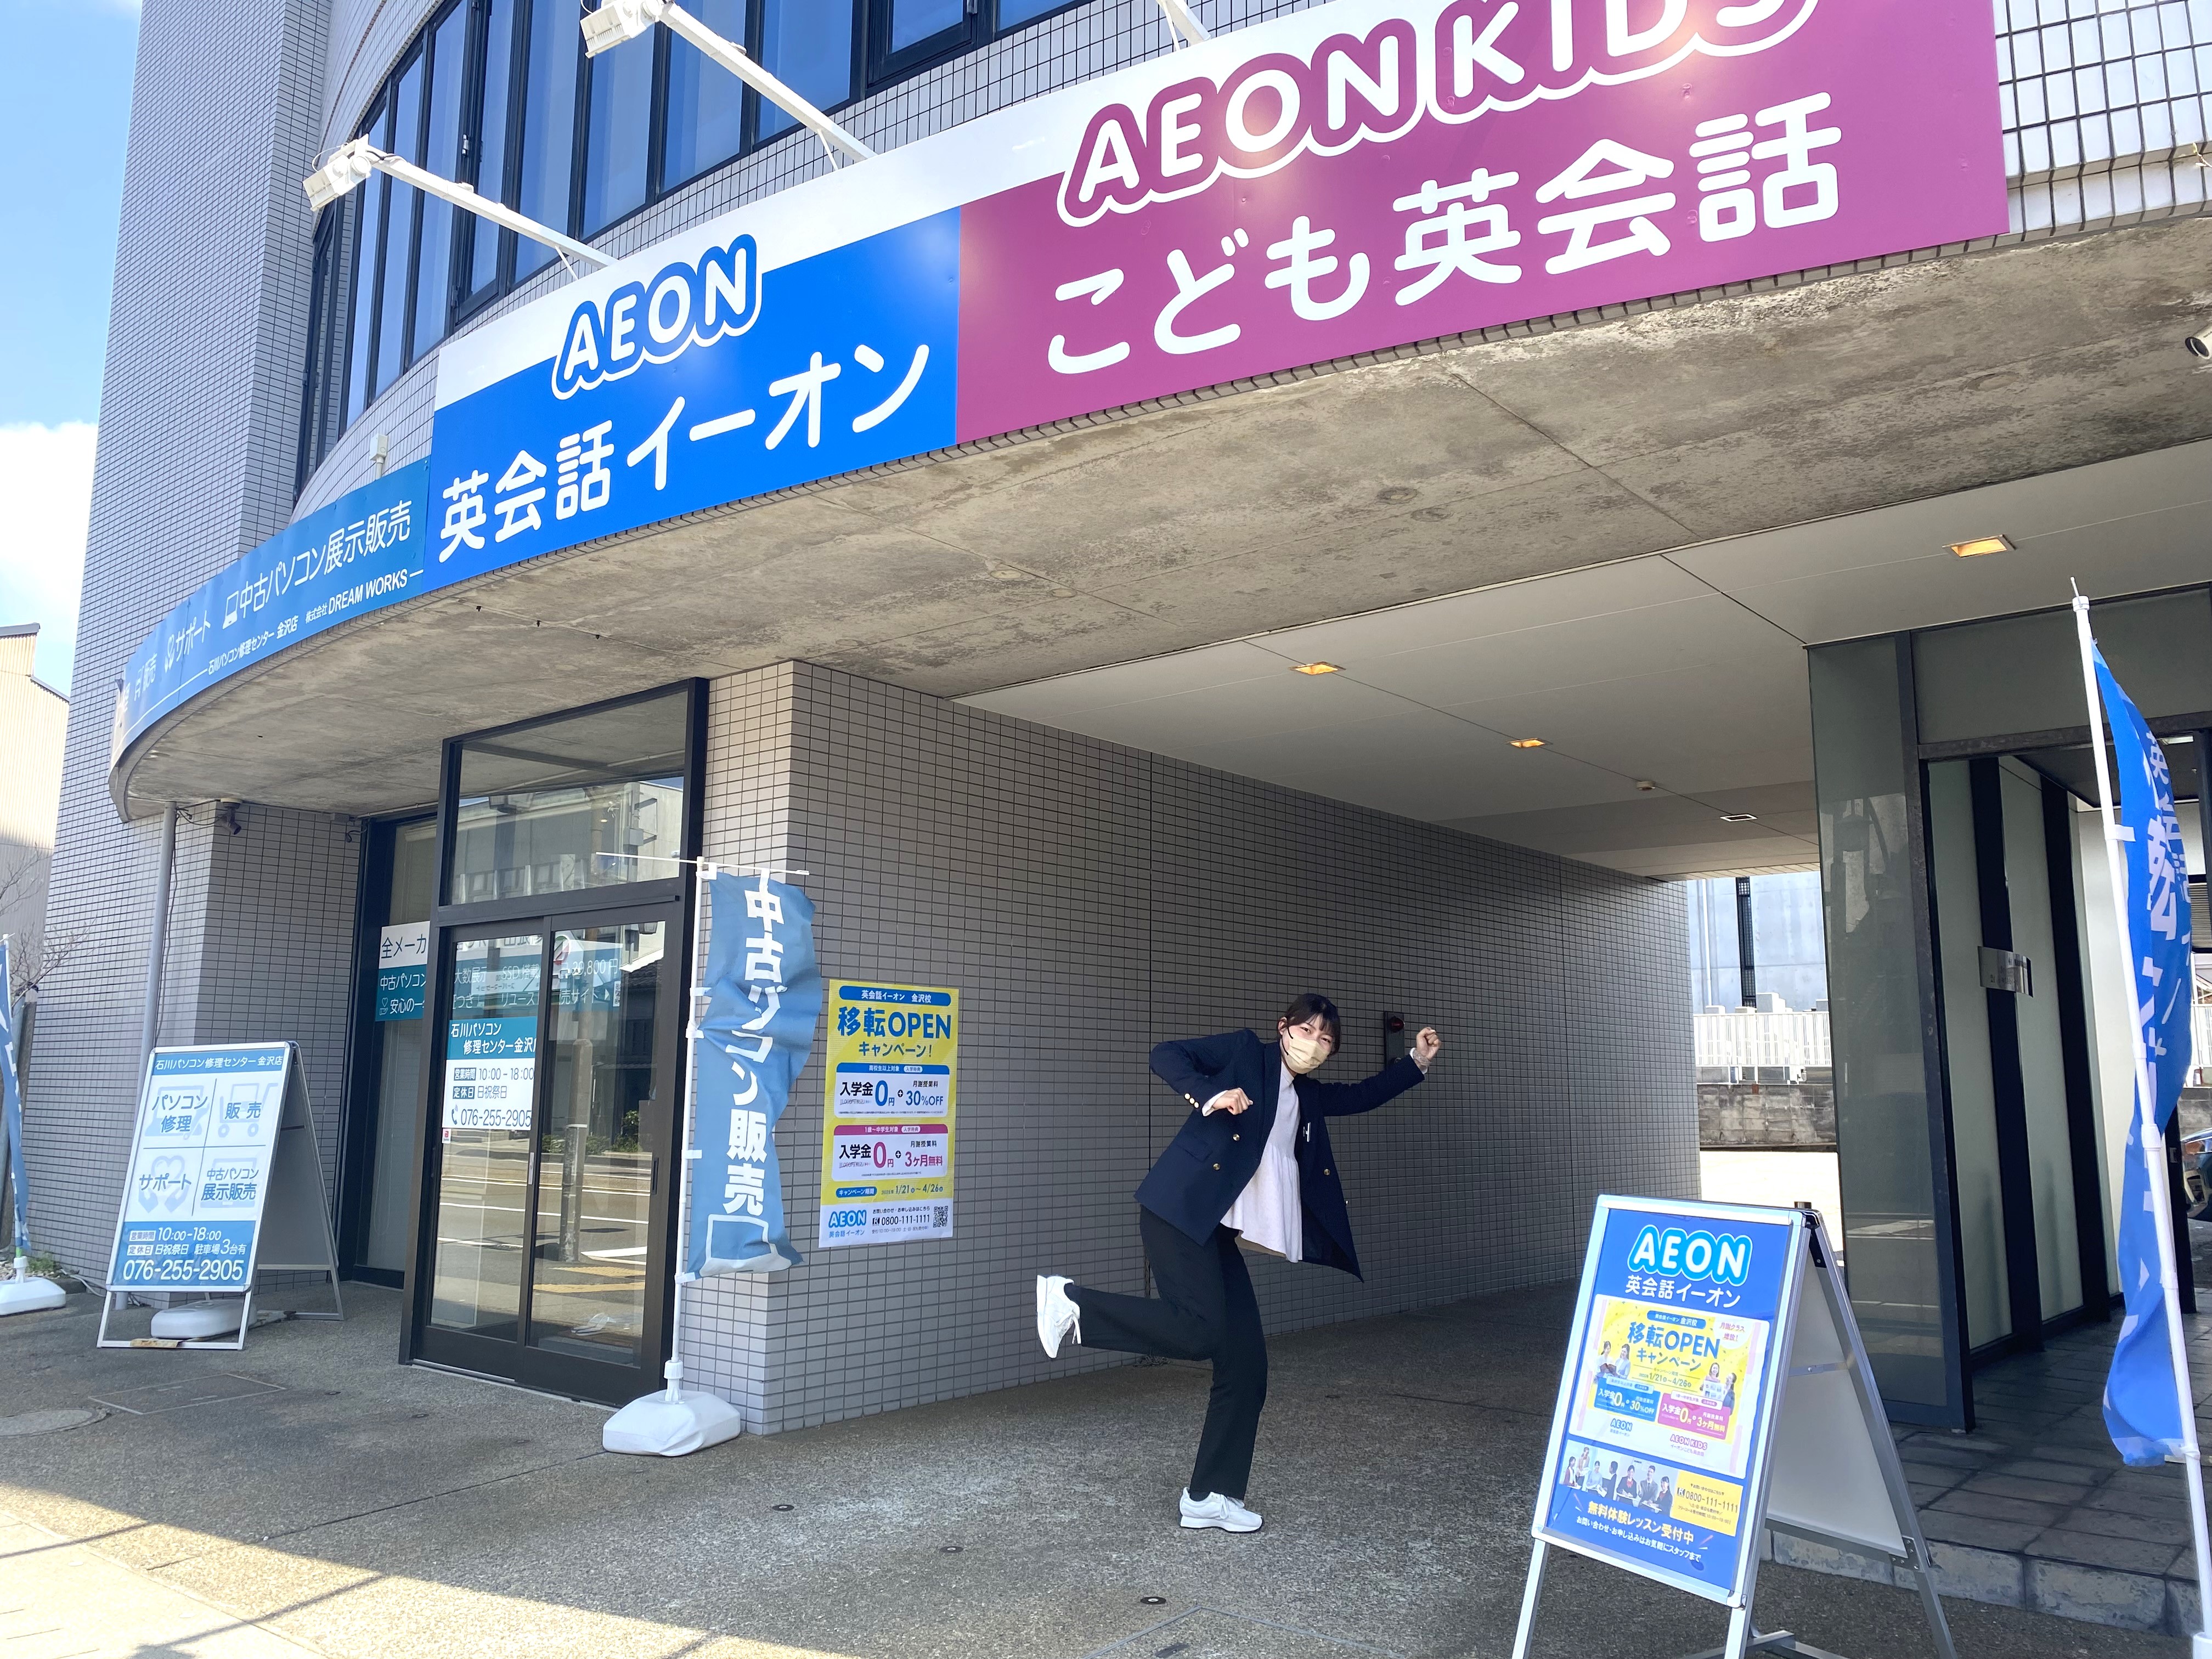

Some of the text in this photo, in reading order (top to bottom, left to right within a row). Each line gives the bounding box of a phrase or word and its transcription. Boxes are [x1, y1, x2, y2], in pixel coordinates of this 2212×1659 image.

[1067, 41, 1406, 215] AEON
[1048, 91, 1842, 375] こども英会話
[557, 240, 755, 391] AEON
[438, 343, 930, 563] 英会話イーオン
[240, 500, 412, 618] 中古パソコン展示販売
[328, 584, 363, 615] DREAM
[365, 568, 408, 600] WORKS
[861, 990, 932, 1003] 英会話イーオン 金沢校
[451, 1023, 501, 1038] 石川パソコン
[837, 1006, 951, 1039] 移転OPEN
[453, 1085, 507, 1099] 定休日 日祝祭日
[152, 1094, 208, 1110] パソコン
[161, 1115, 191, 1133] 修理
[461, 1109, 531, 1127] 076-255-2905
[139, 1173, 191, 1191] サポート
[207, 1167, 259, 1181] 中古パソコン
[201, 1183, 257, 1200] 展示販売
[828, 1210, 867, 1228] AEON
[881, 1214, 930, 1226] 0800-111-1111
[158, 1227, 221, 1241] 10:00-18:00
[129, 1246, 152, 1255] 定休日
[1629, 1227, 1750, 1283] AEON
[123, 1260, 244, 1280] 076-255-2905
[1625, 1274, 1741, 1308] 英会話イーオン
[1627, 1322, 1720, 1359] 移転OPEN
[1637, 1347, 1701, 1372] キャンペーン
[1610, 1418, 1633, 1432] AEON
[1670, 1434, 1707, 1451] AEON KIDS
[1685, 1491, 1738, 1514] 0800-111-1111
